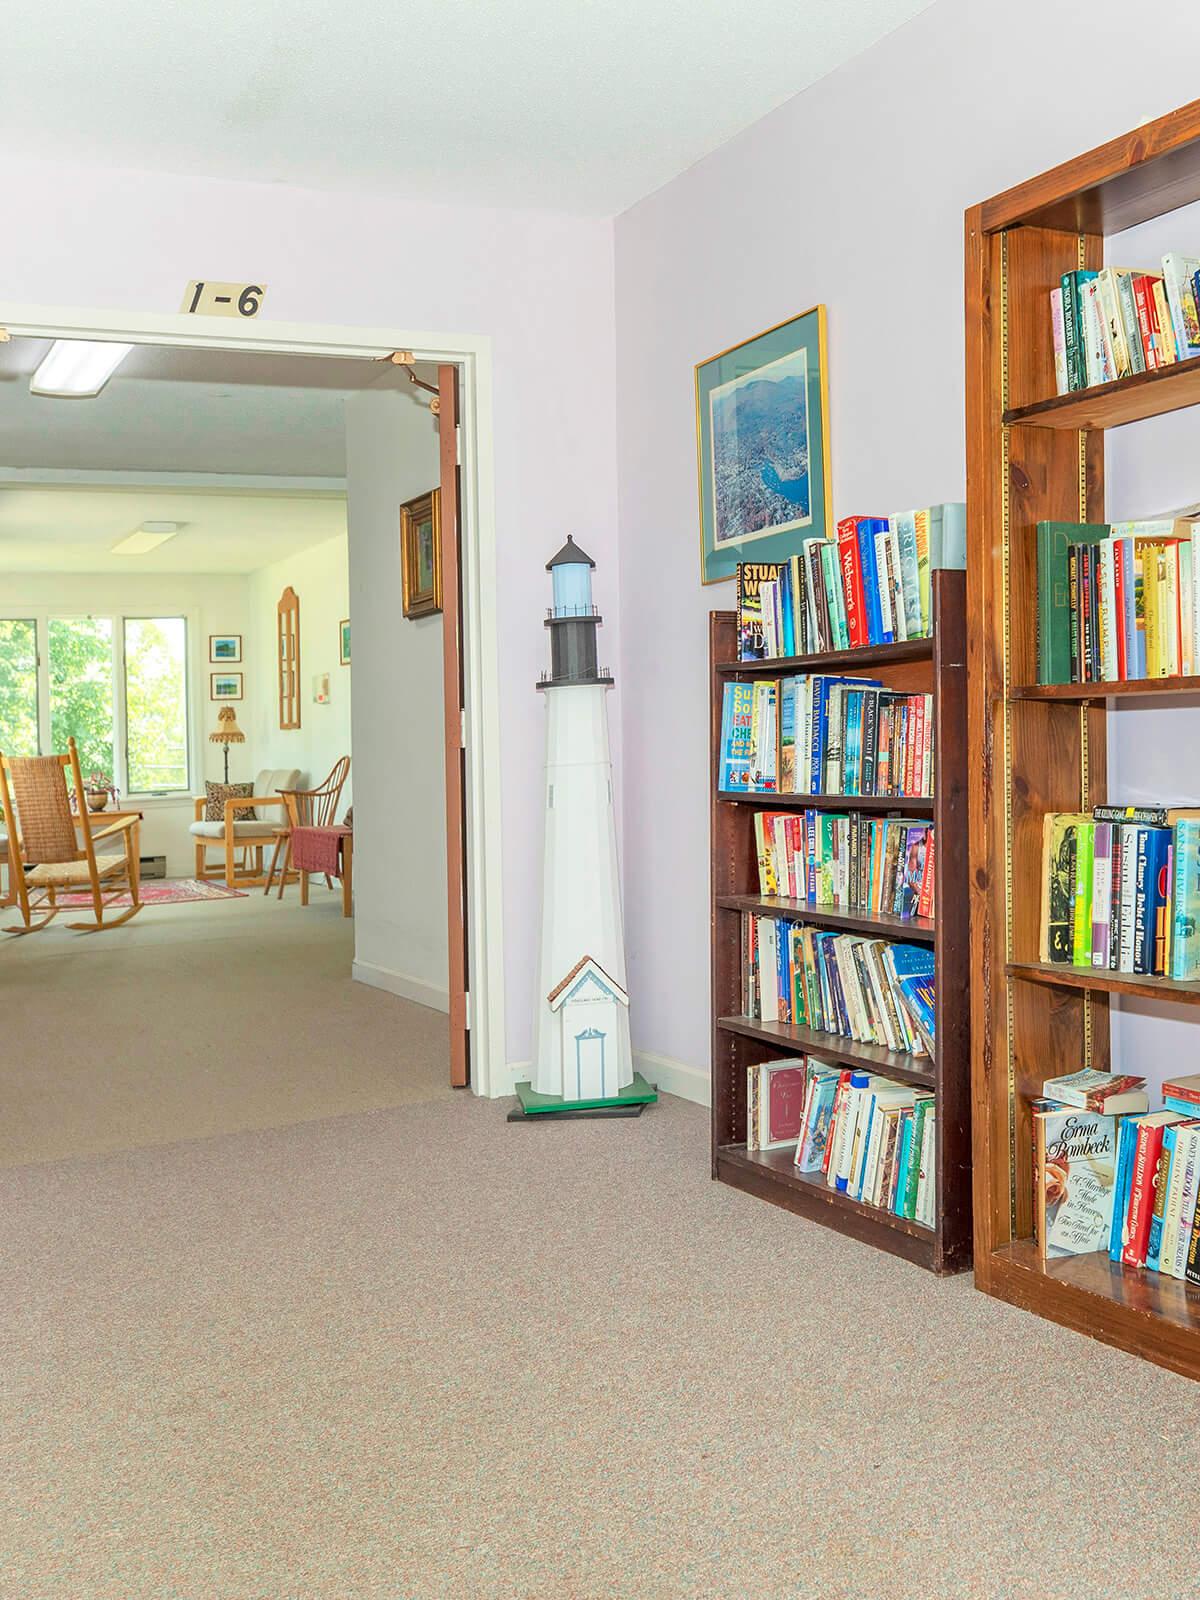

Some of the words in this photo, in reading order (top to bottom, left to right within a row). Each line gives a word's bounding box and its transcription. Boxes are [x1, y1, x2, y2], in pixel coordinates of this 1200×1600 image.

[1063, 287, 1073, 312] NORA
[1065, 311, 1075, 347] ROBERTS
[1101, 598, 1109, 649] TRUMP
[1138, 831, 1148, 853] Tom
[1176, 822, 1186, 862] SAND
[1135, 853, 1147, 890] Clancy
[1136, 892, 1146, 914] Debt
[1175, 868, 1185, 921] RIVERS
[1136, 914, 1145, 929] of
[1135, 930, 1144, 964] Honor
[1061, 1116, 1099, 1142] Erma
[1048, 1135, 1110, 1159] Bombeck
[1175, 1140, 1185, 1156] THE
[1188, 1135, 1198, 1160] SIDNEY
[1172, 1158, 1183, 1184] SILENT
[1184, 1160, 1195, 1193] SHELDON
[1169, 1186, 1179, 1218] PATIENT
[1188, 1229, 1200, 1265] Dragon
